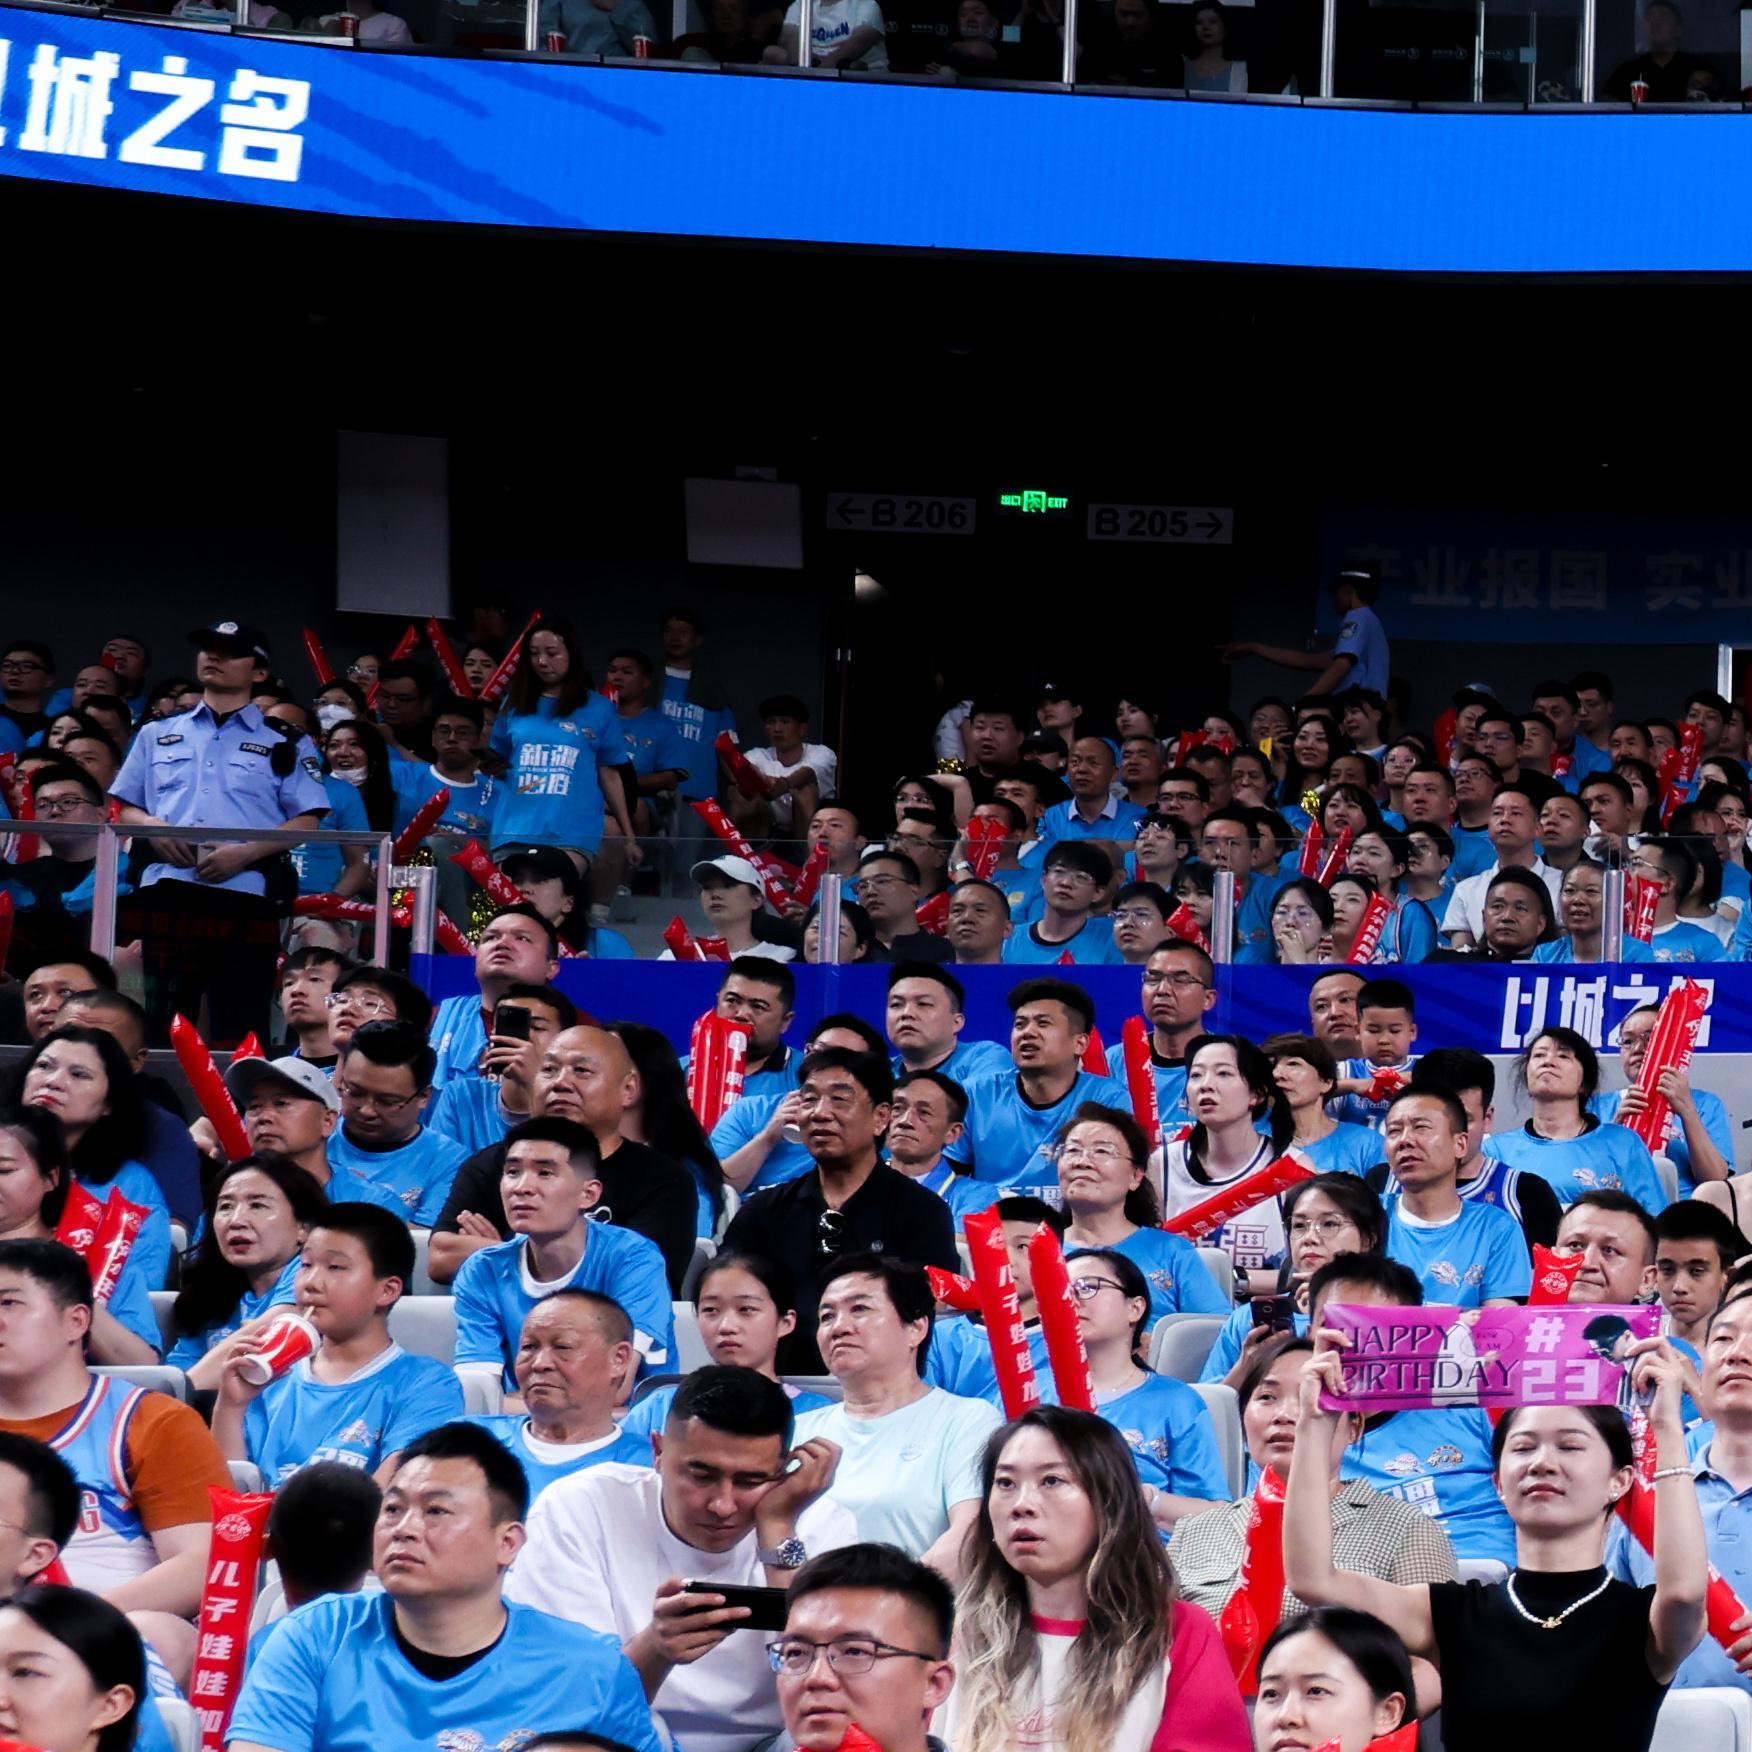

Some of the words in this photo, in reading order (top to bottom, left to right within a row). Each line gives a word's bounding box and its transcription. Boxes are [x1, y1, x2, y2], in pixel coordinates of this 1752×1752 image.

[0, 43, 310, 182] 城之名
[1338, 1324, 1460, 1357] HAPPY
[1342, 1359, 1519, 1393] BIRTHDAY
[1521, 1358, 1600, 1401] 23
